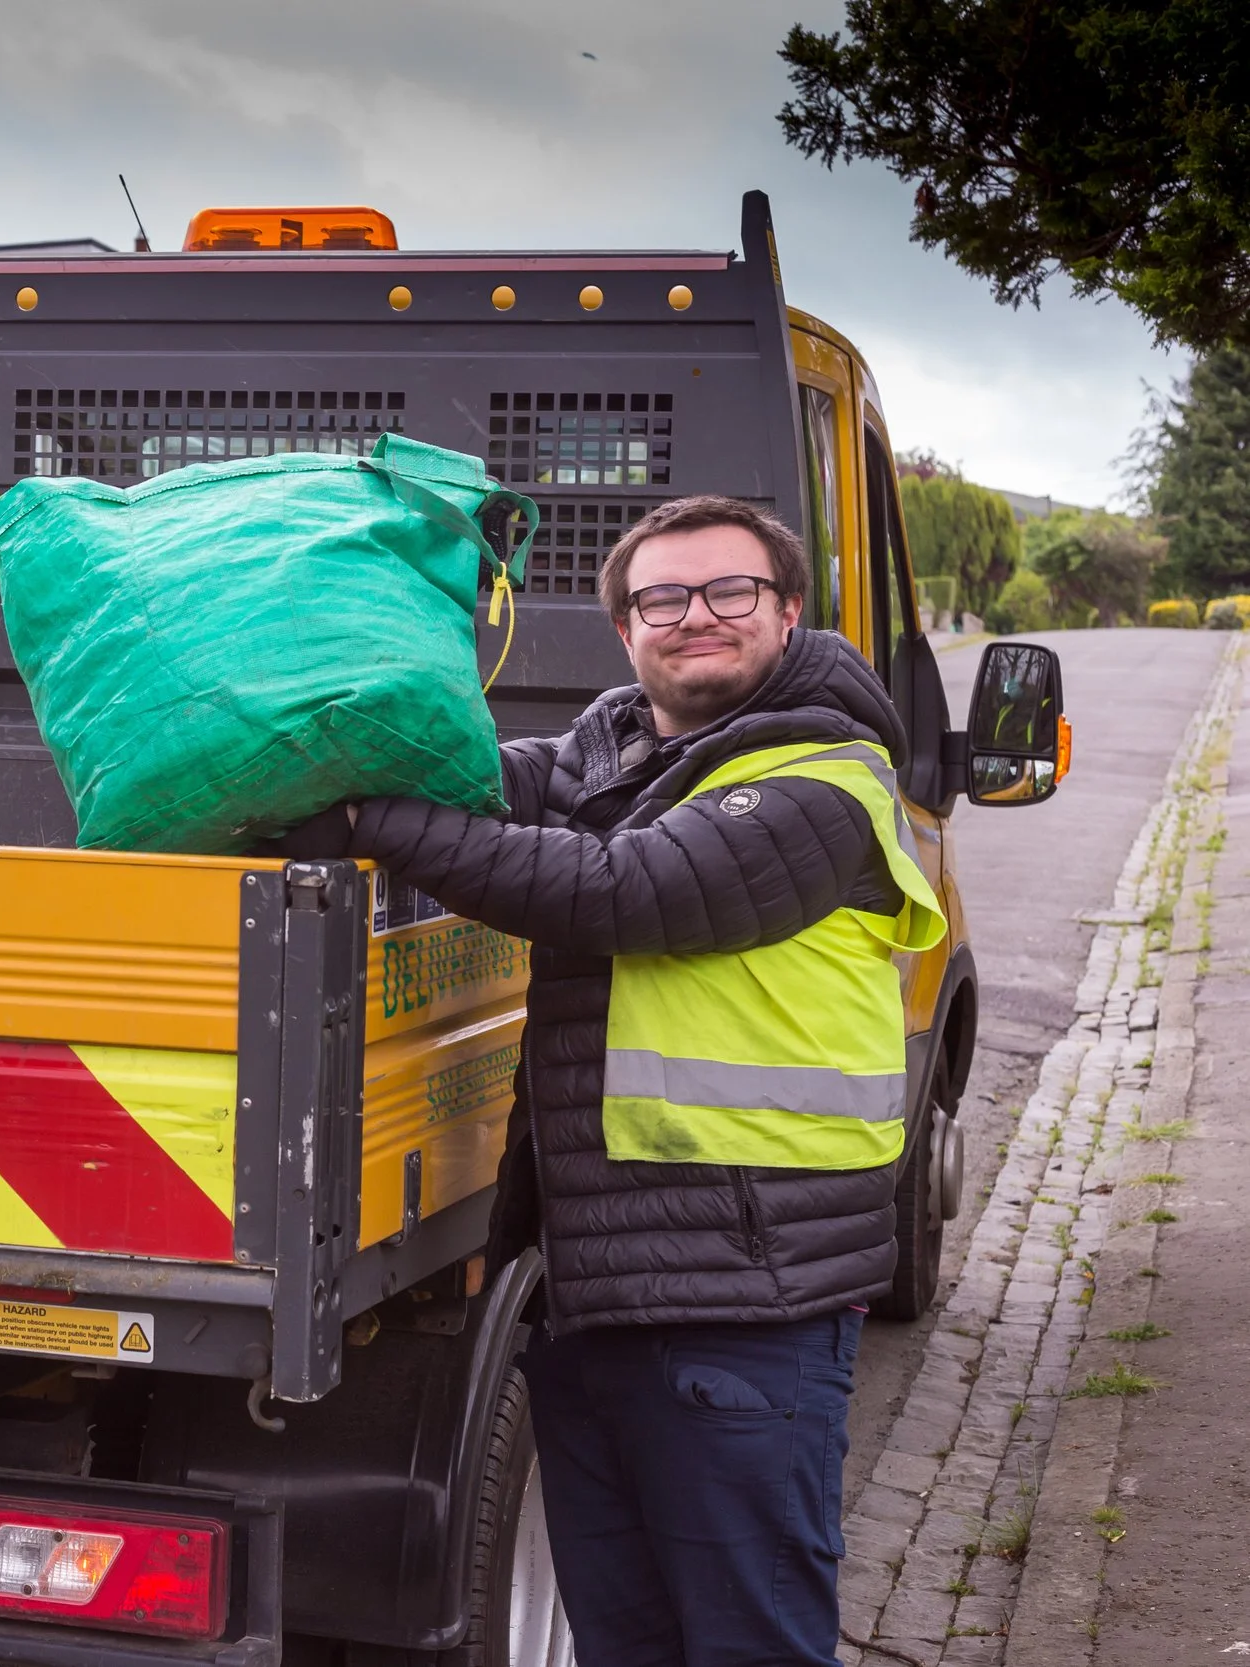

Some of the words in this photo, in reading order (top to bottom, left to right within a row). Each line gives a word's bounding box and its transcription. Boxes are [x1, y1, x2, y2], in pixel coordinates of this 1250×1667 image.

[3, 1304, 47, 1317] HAZARD
[1, 1316, 26, 1325] position
[26, 1319, 55, 1327] obscures
[56, 1321, 78, 1330] vehicle
[92, 1324, 110, 1333] lights
[9, 1324, 26, 1332] when
[27, 1327, 57, 1336] stationary
[68, 1330, 87, 1339] public
[87, 1332, 114, 1342] highway
[0, 1330, 20, 1339] similar
[20, 1333, 46, 1343] warning
[46, 1336, 67, 1344] device
[67, 1338, 89, 1346] should
[98, 1341, 114, 1349] used
[14, 1340, 47, 1350] instruction
[48, 1344, 71, 1352] manual
